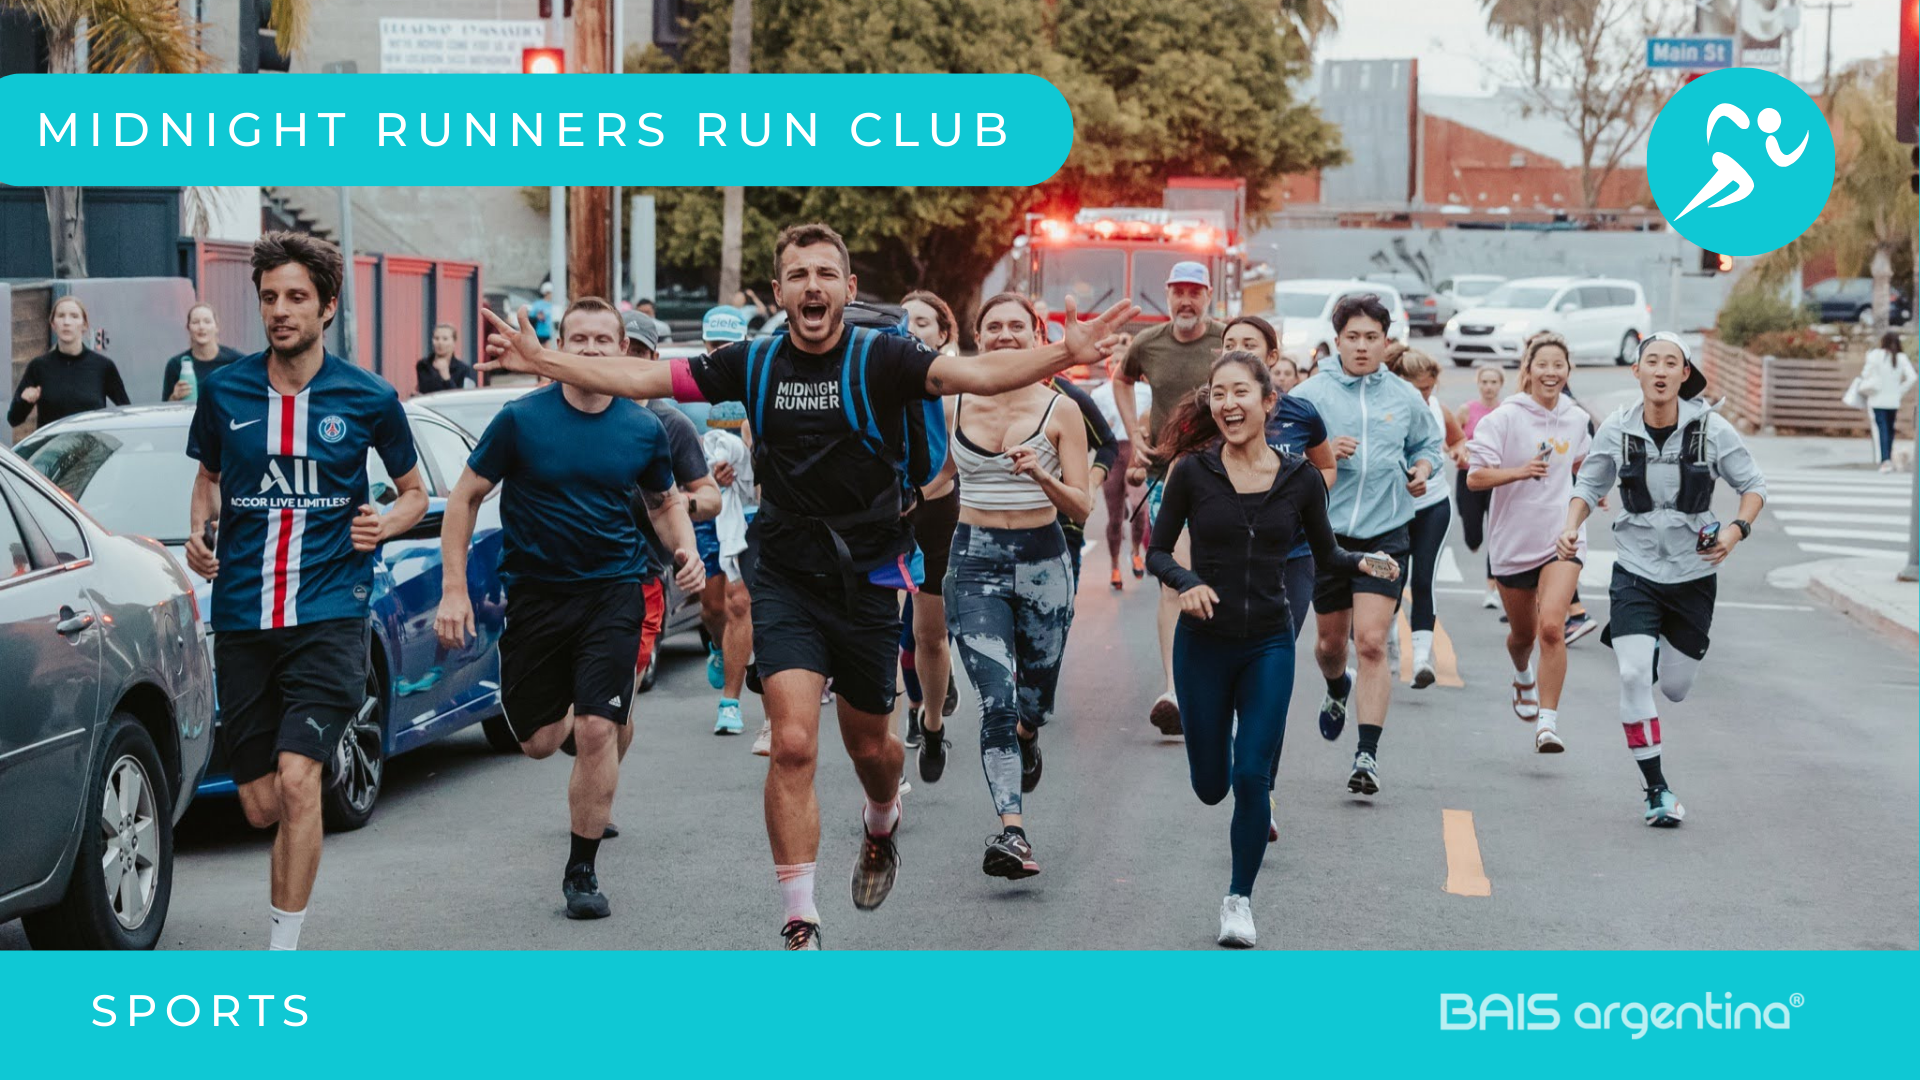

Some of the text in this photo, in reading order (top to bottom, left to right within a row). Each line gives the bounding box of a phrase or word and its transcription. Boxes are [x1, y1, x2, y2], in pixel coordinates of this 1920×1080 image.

[1653, 42, 1699, 62] Main
[1703, 43, 1726, 62] St
[710, 318, 738, 330] ciele
[777, 381, 839, 396] MIDNIGH
[774, 394, 840, 410] RUNNER
[231, 497, 351, 508] ACCOR LIVE LIMITLESS
